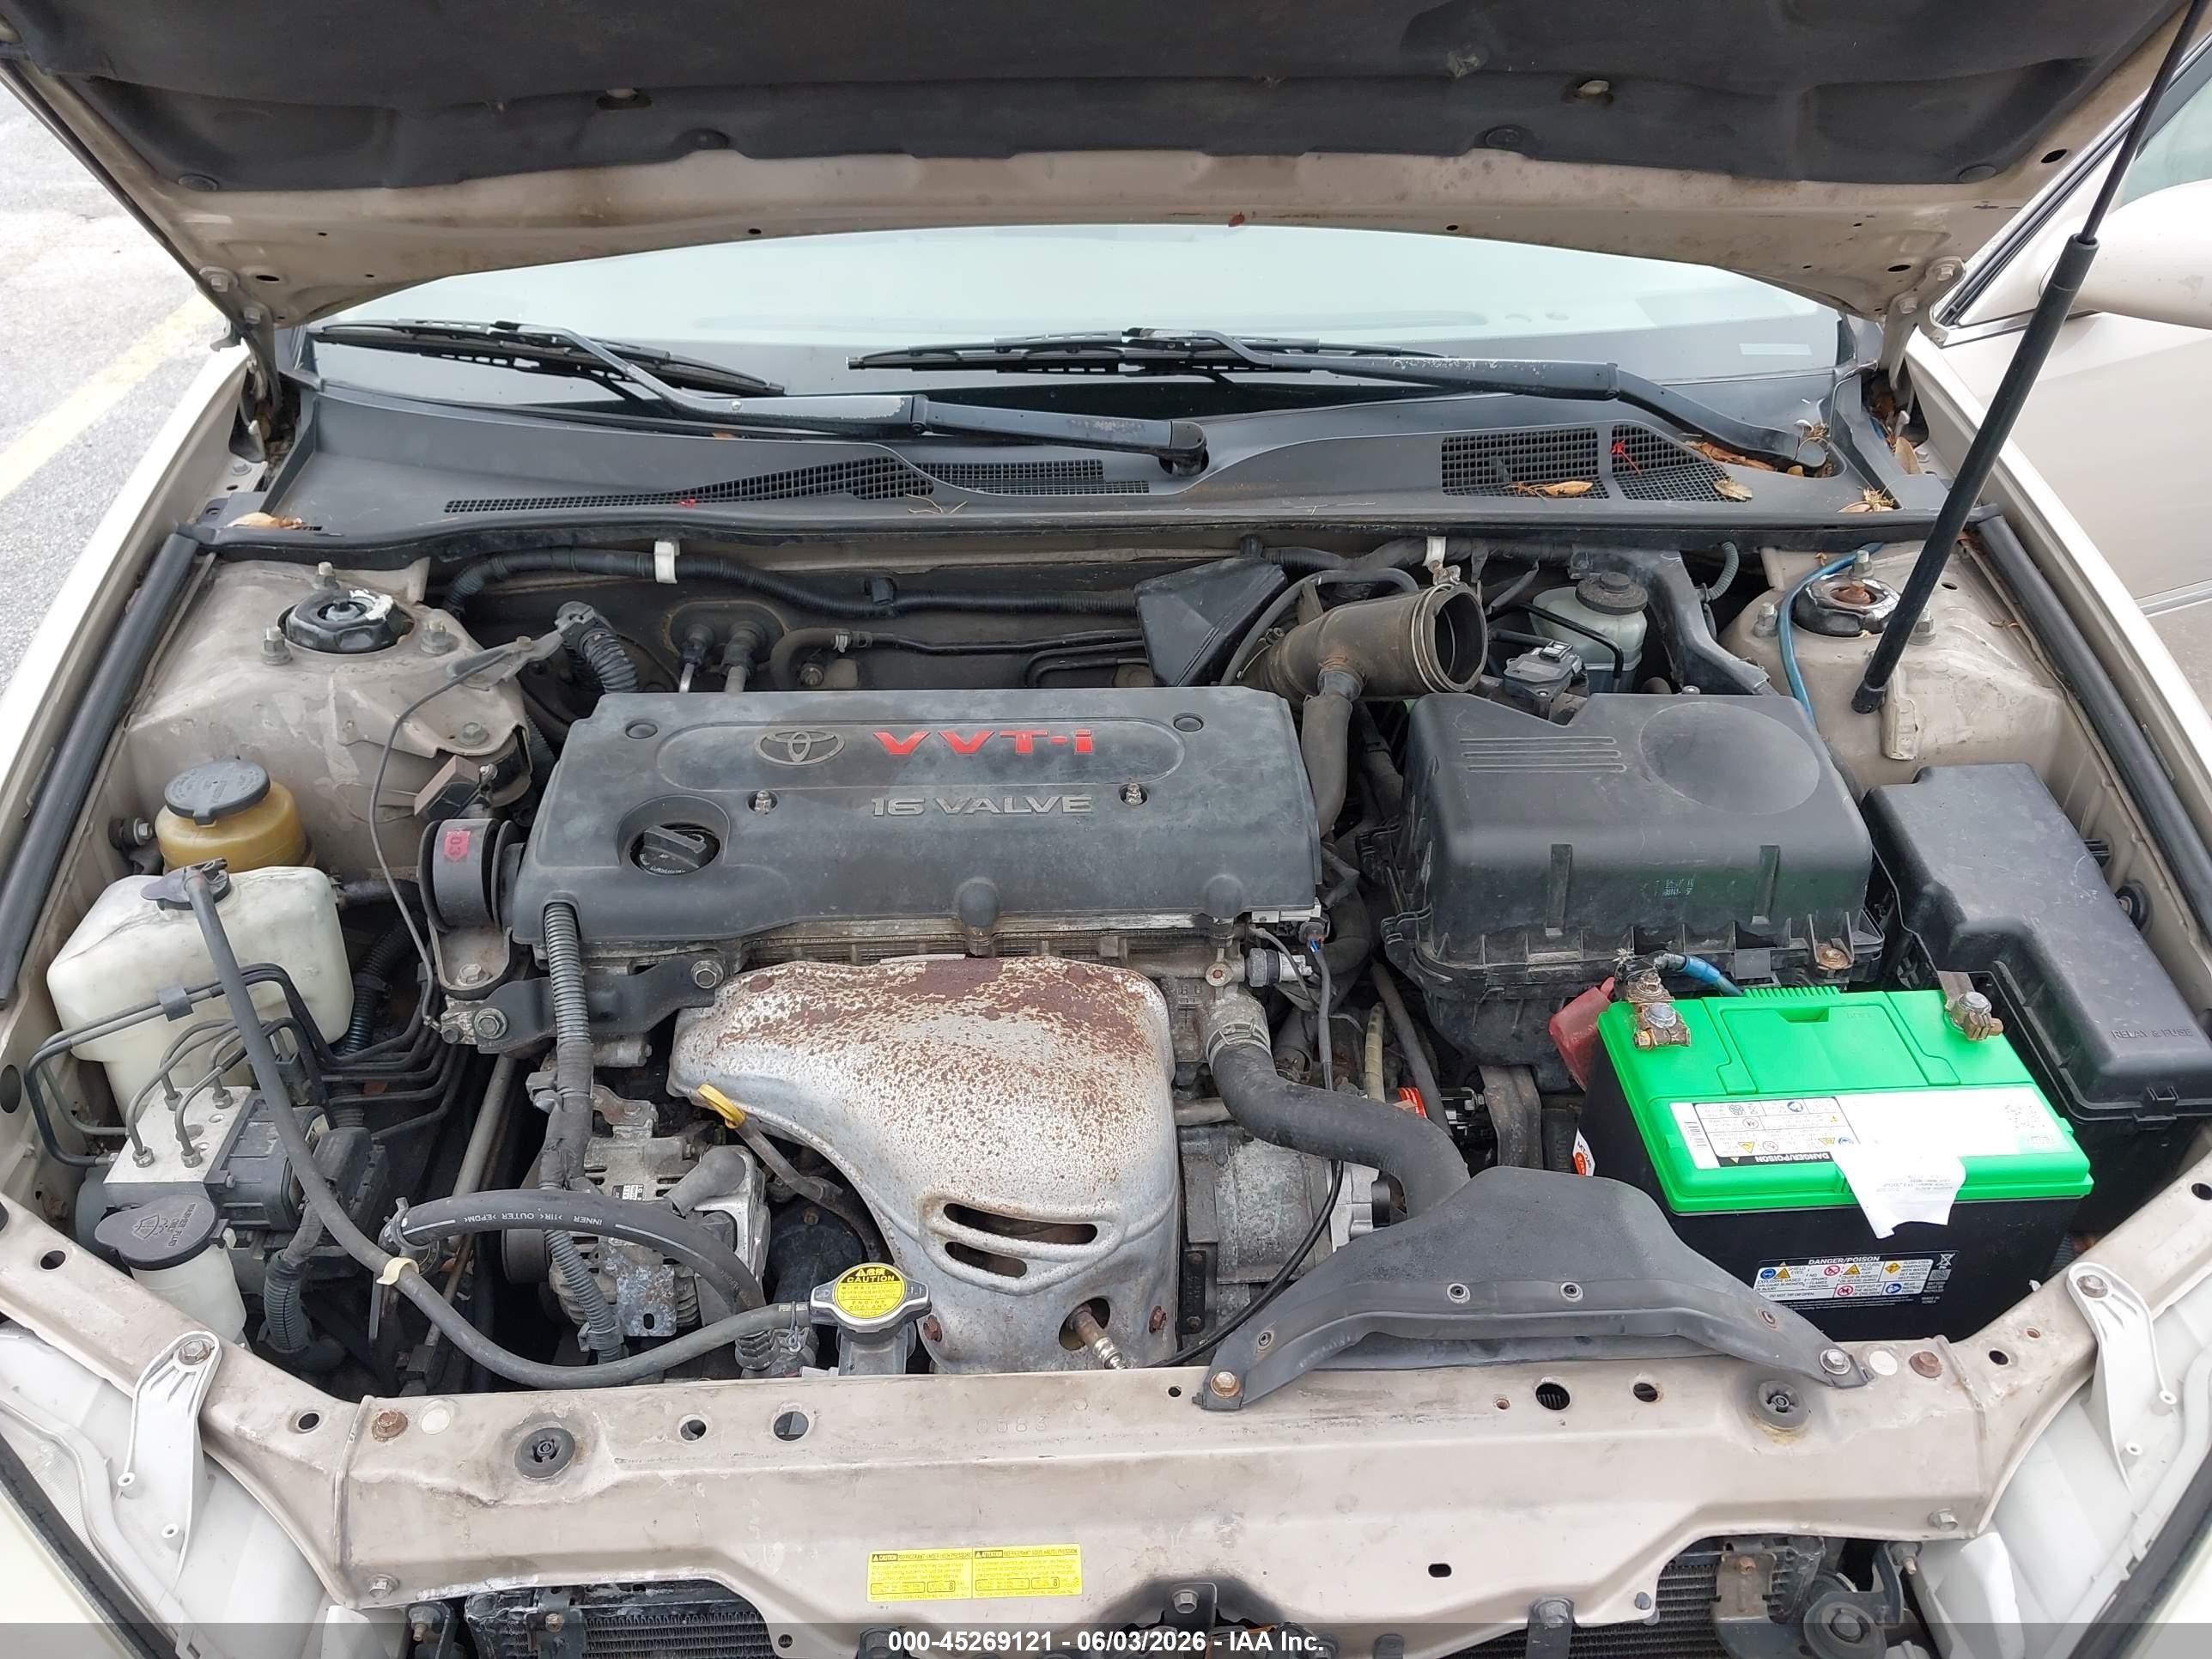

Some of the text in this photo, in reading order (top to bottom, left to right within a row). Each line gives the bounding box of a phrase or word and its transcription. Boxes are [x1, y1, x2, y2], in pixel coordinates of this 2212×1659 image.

[872, 729, 1093, 756] VVT-i
[871, 796, 1093, 816] 16 VALVE
[2112, 1030, 2148, 1039] RELAY
[2163, 1029, 2193, 1038] FUSE
[1754, 1152, 1830, 1164] DANGER/POISON
[501, 1212, 535, 1221] OUTER
[573, 1215, 603, 1226] INNER
[1808, 1256, 1881, 1266] DANGER/POISON
